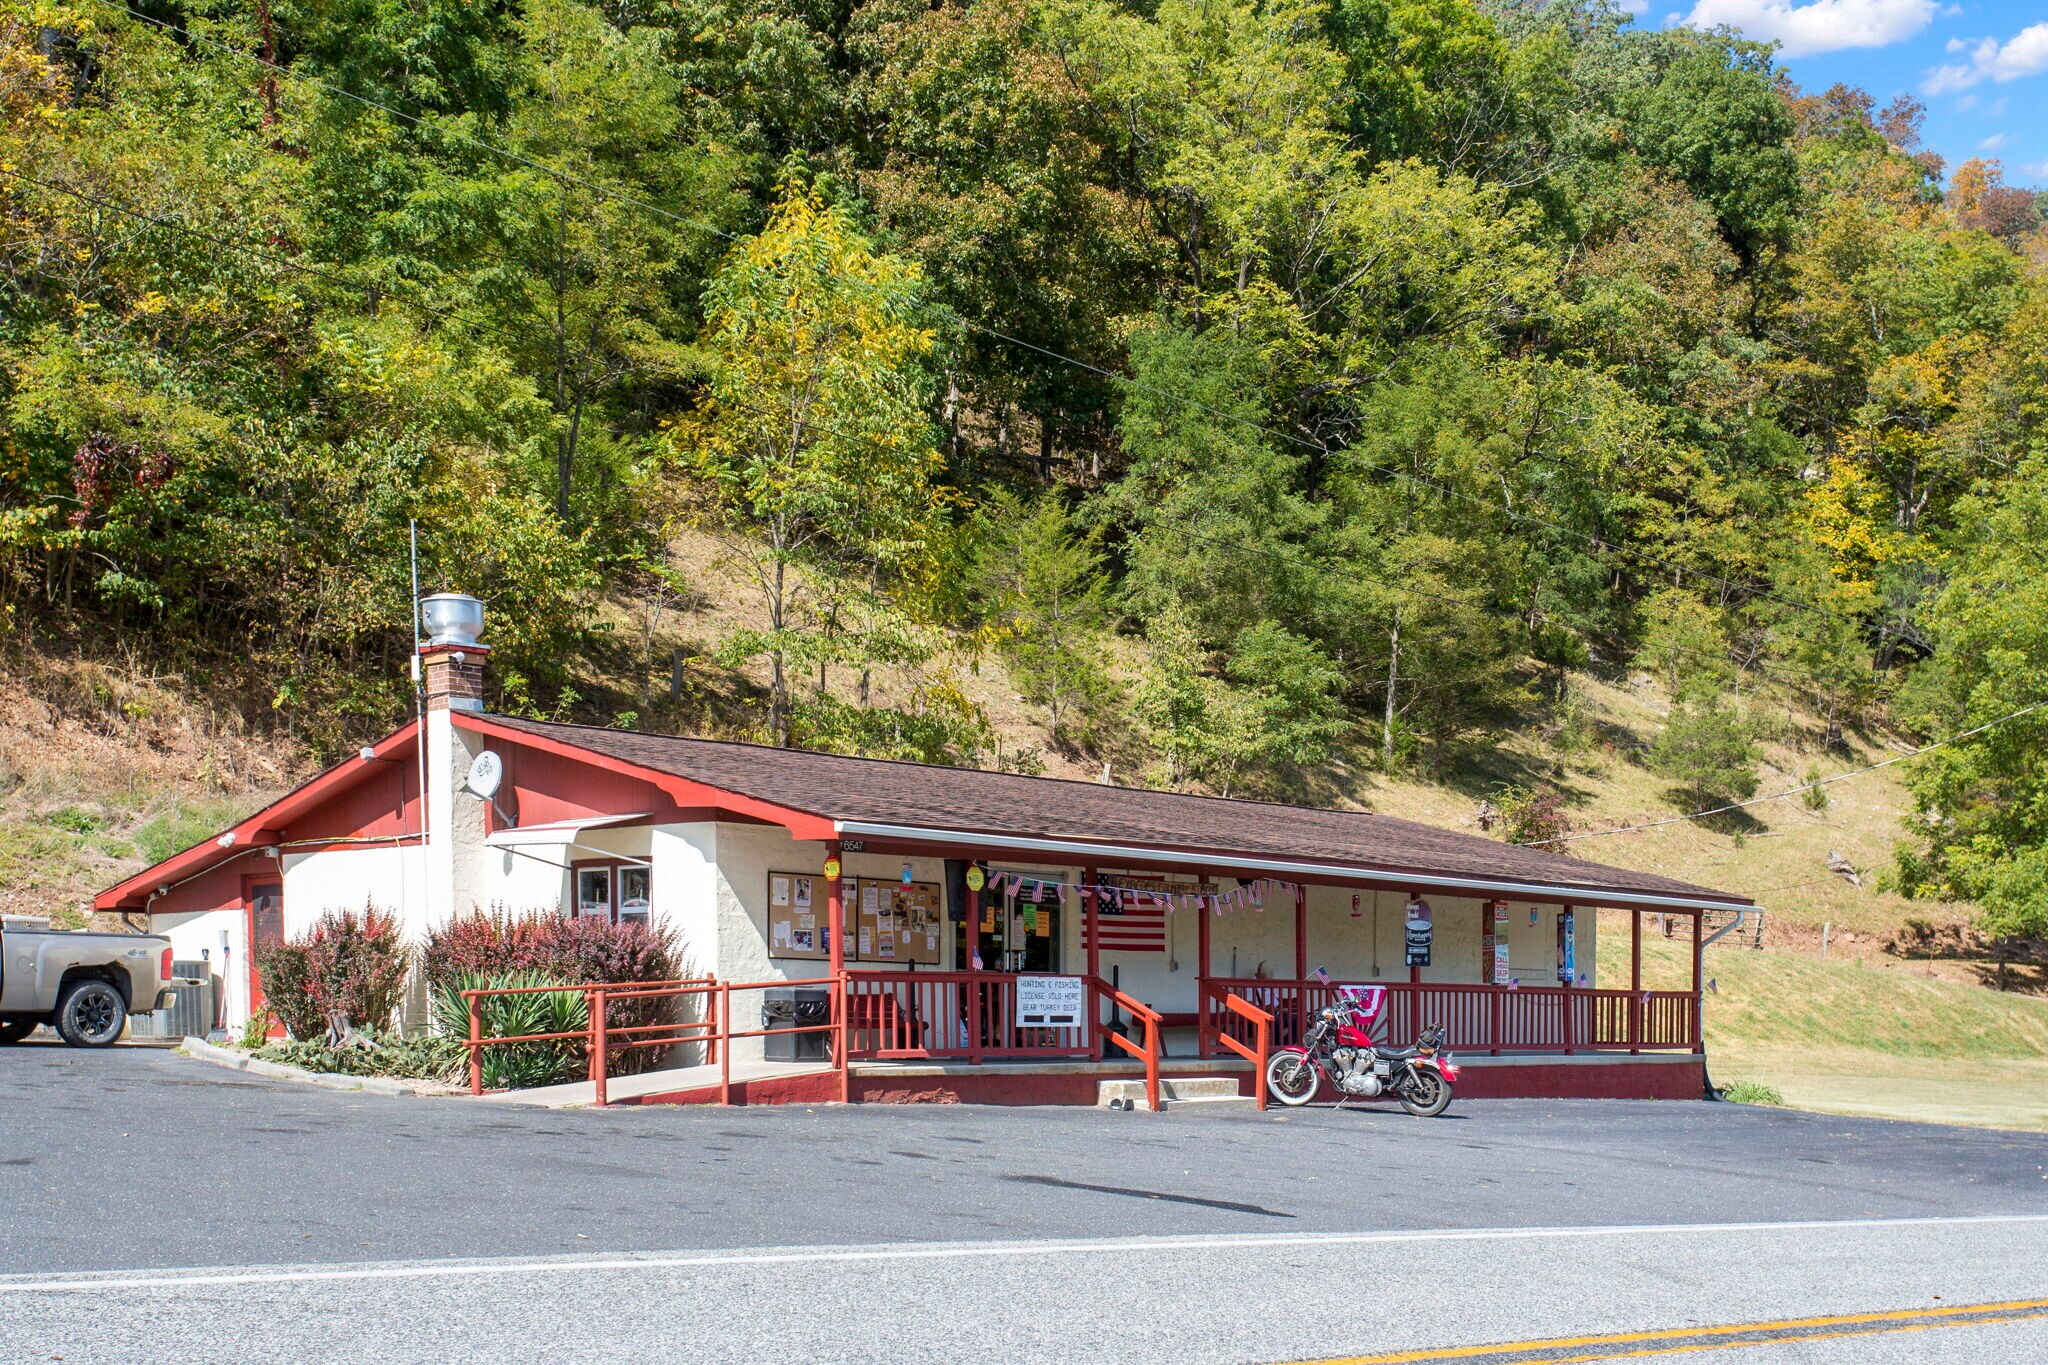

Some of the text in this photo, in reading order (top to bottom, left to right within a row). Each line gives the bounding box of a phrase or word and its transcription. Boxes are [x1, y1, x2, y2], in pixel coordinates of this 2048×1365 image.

[843, 841, 863, 851] 6547
[1055, 981, 1079, 989] FISHING
[1021, 992, 1045, 1000] LICENSE
[1040, 1003, 1060, 1011] TURKEY
